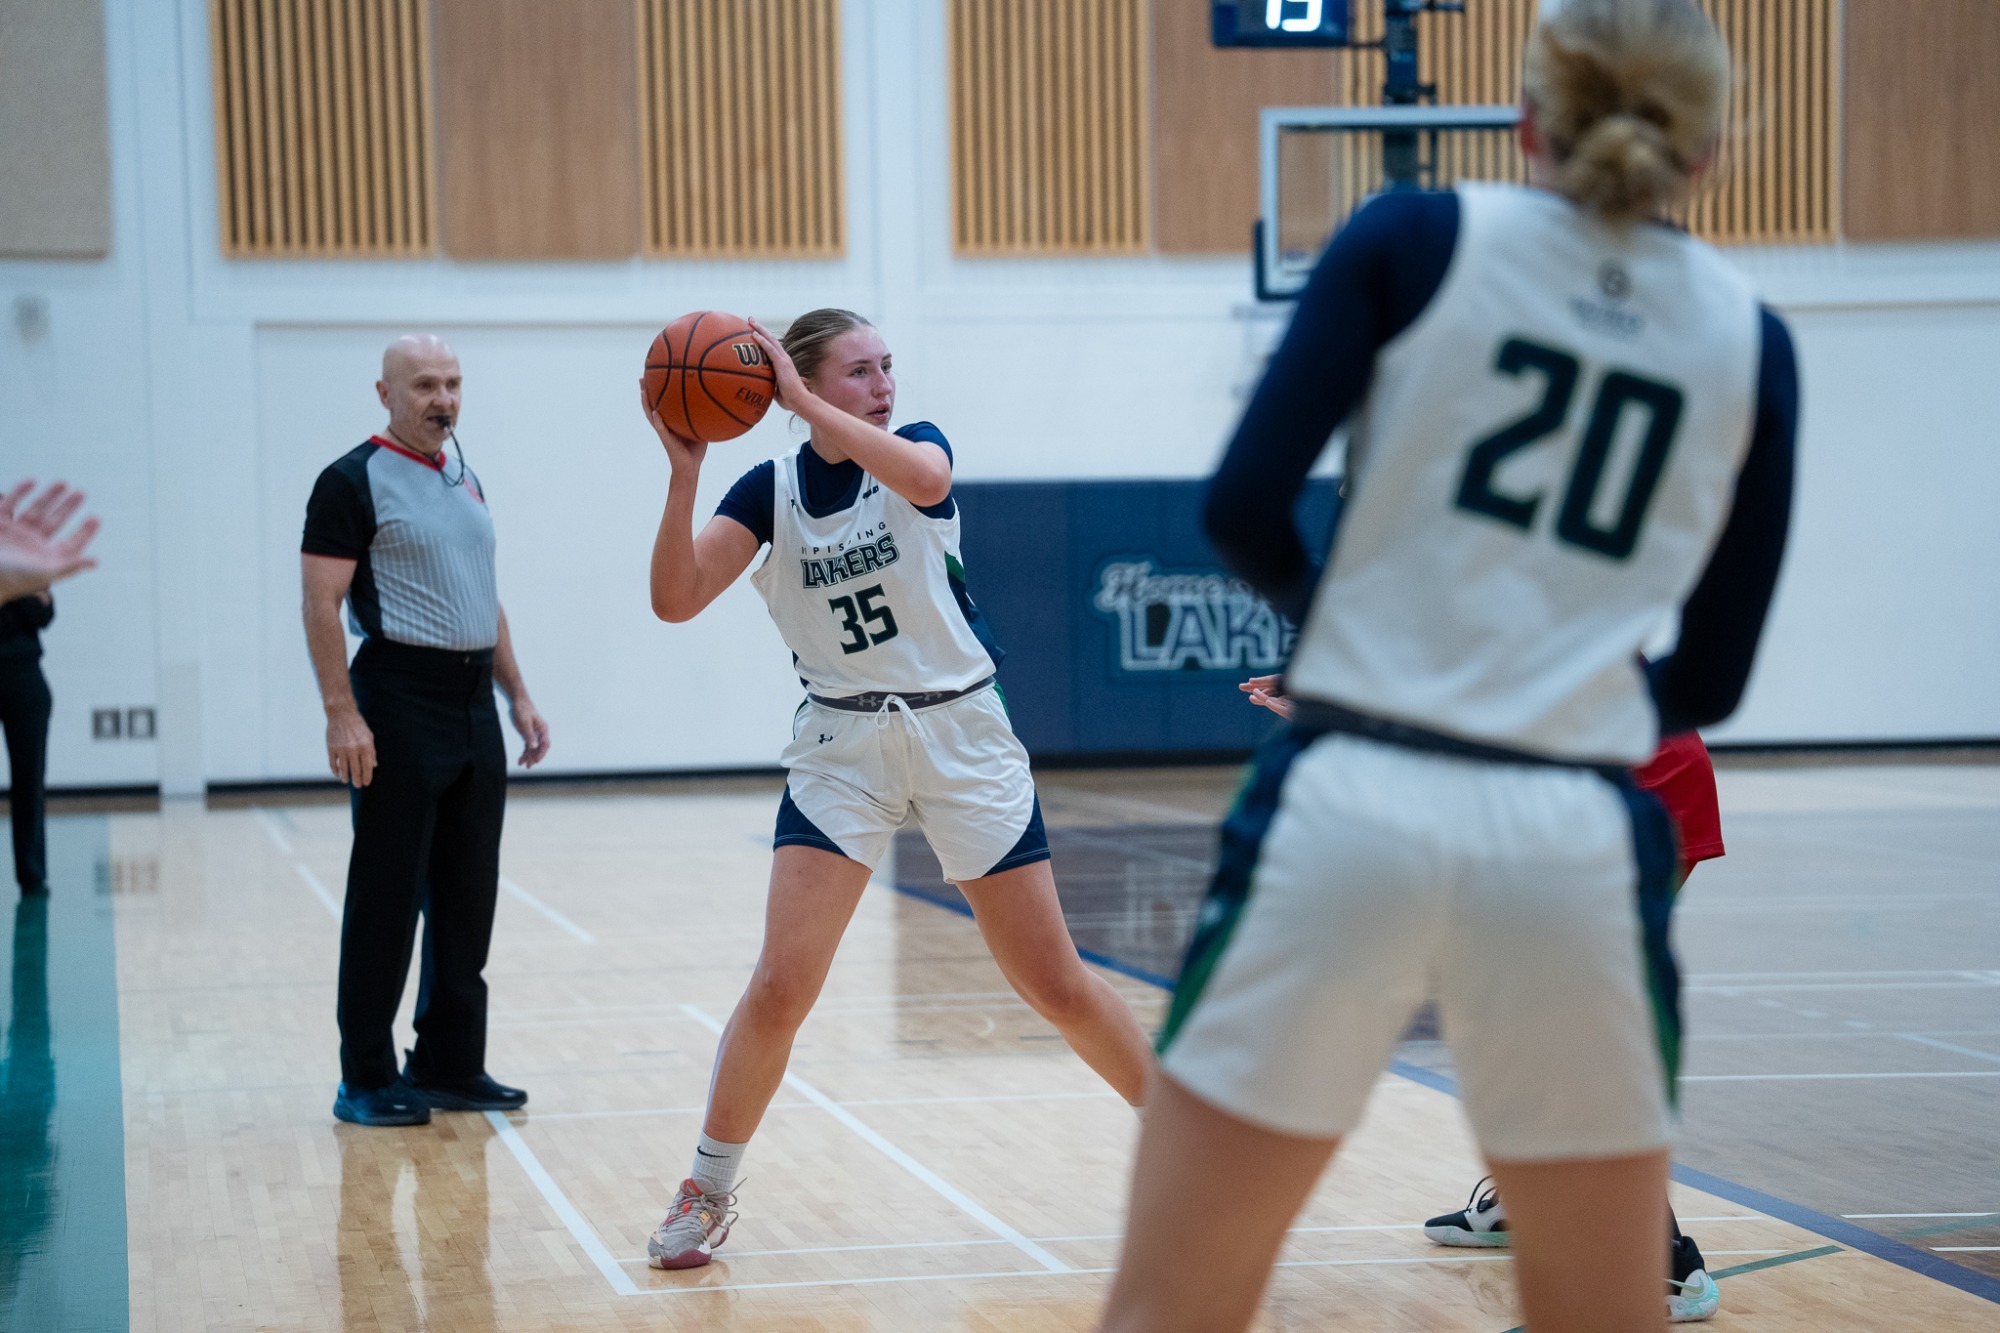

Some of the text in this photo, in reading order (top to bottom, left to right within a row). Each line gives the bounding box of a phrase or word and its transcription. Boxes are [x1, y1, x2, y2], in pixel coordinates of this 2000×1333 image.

[1454, 336, 1685, 561] 20
[800, 532, 900, 590] LAKERS
[828, 583, 899, 656] 35
